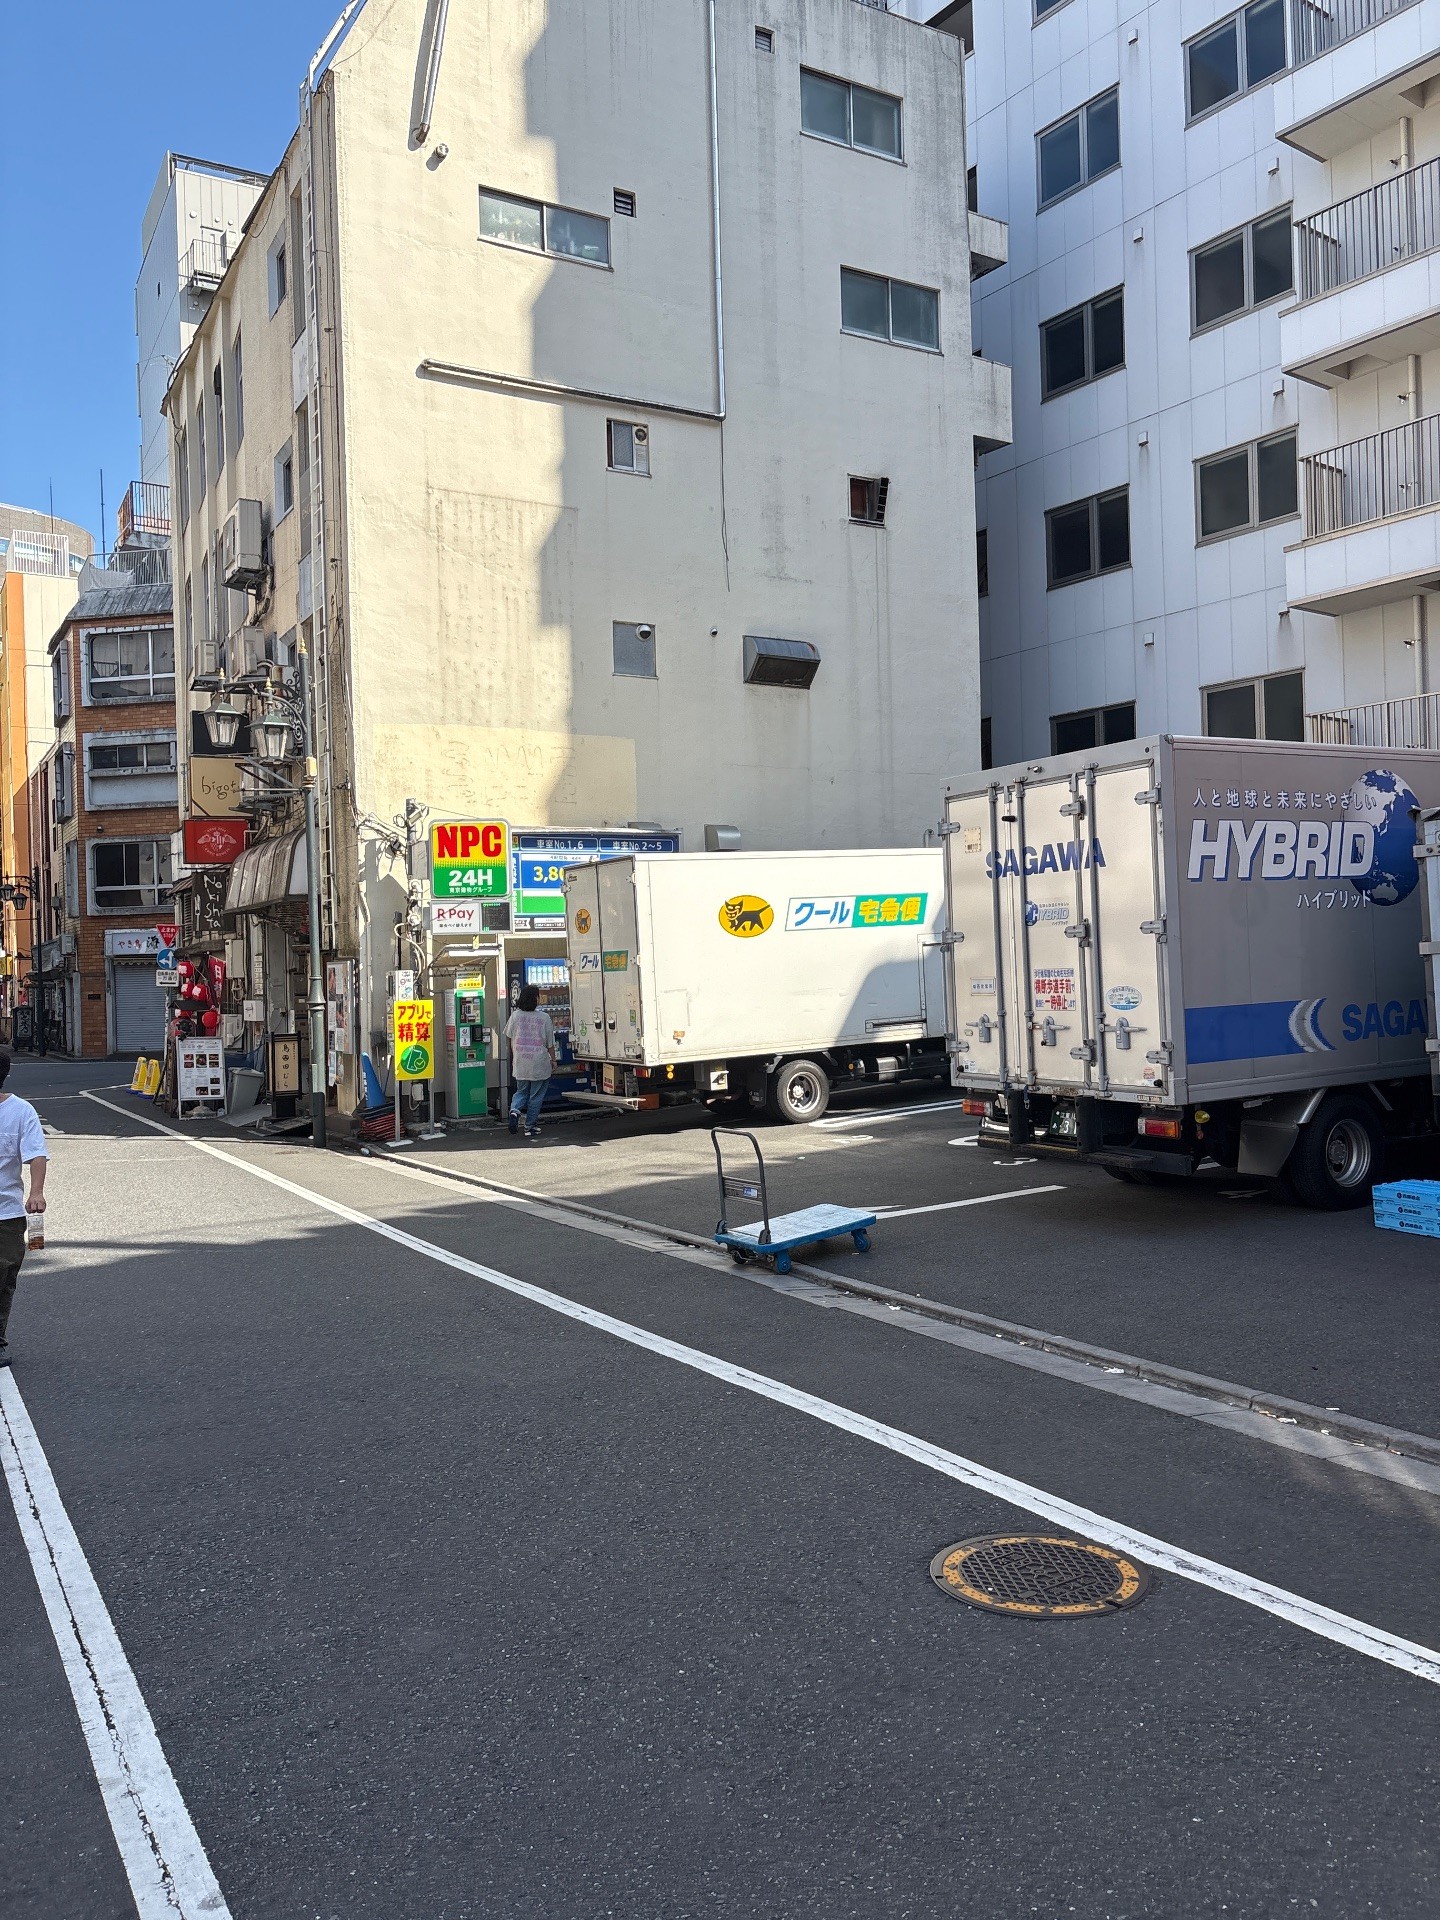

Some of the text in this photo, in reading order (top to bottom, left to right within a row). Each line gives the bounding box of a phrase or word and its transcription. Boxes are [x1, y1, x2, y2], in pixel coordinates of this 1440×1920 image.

[1193, 787, 1378, 811] 人と地球と未来にやさしい
[437, 825, 502, 858] NPC
[1187, 819, 1375, 882] HYBRID
[985, 837, 1107, 880] SAGAWA
[448, 868, 493, 887] 24H
[1296, 889, 1372, 910] ハイブリッド
[794, 896, 921, 927] クール 宅急便
[1031, 907, 1070, 921] HYBRID
[581, 954, 600, 970] クール
[398, 1004, 431, 1021] アプリで
[1342, 999, 1428, 1042] SAGA
[398, 1021, 430, 1043] 精算
